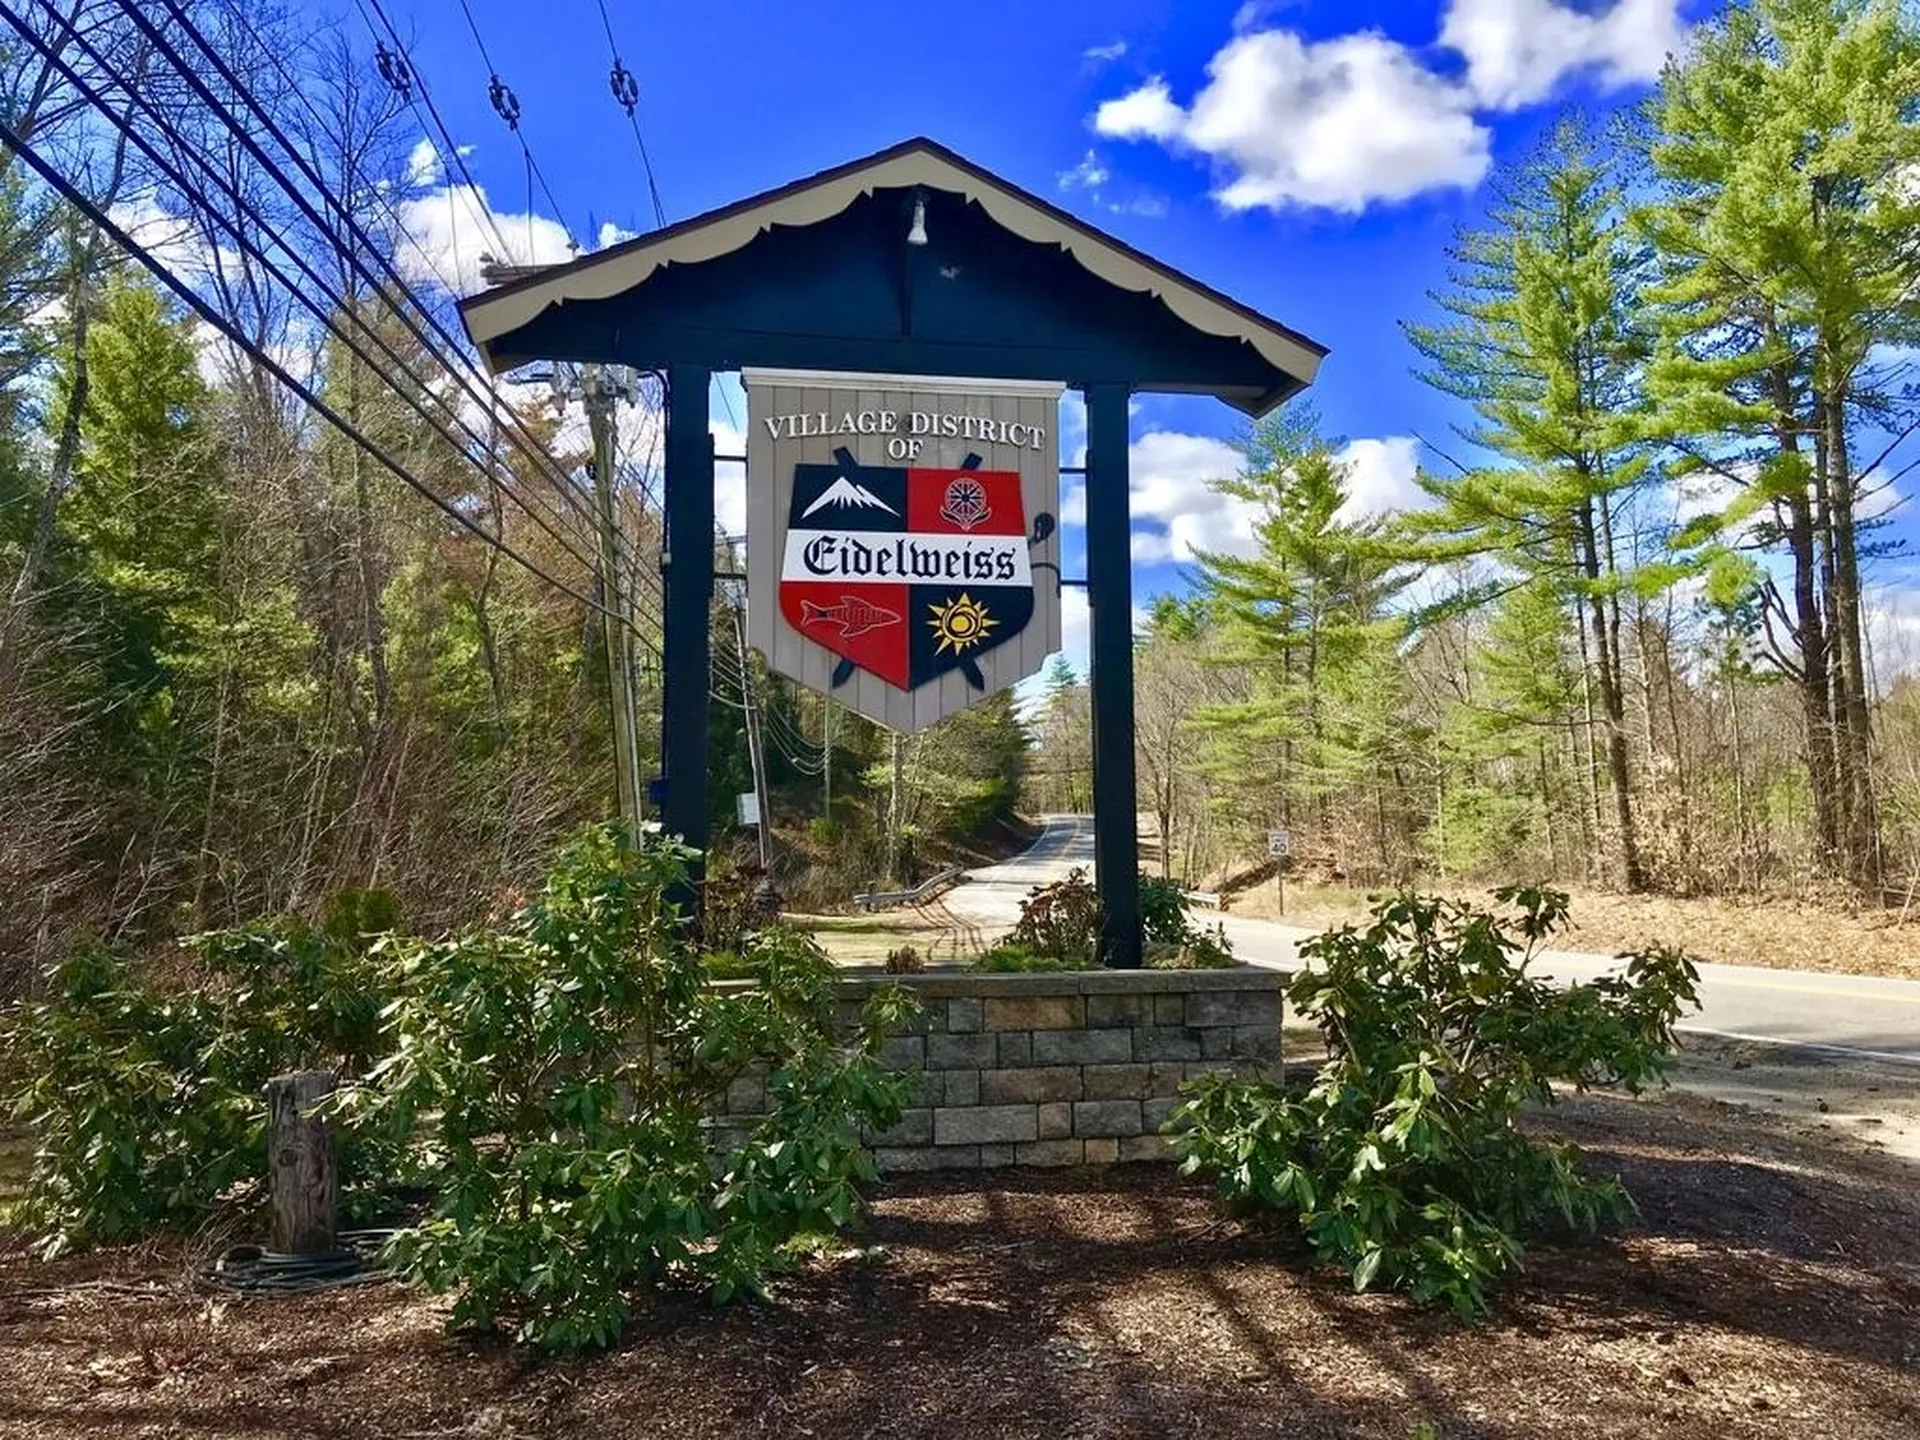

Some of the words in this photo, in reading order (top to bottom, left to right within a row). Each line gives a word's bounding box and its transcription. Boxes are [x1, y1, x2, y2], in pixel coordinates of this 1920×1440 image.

[764, 411, 897, 440] VILLAGE
[909, 411, 1045, 450] DISTRICT
[887, 437, 925, 460] OF
[803, 534, 1016, 581] Eidelweiss
[1272, 843, 1287, 854] 40
